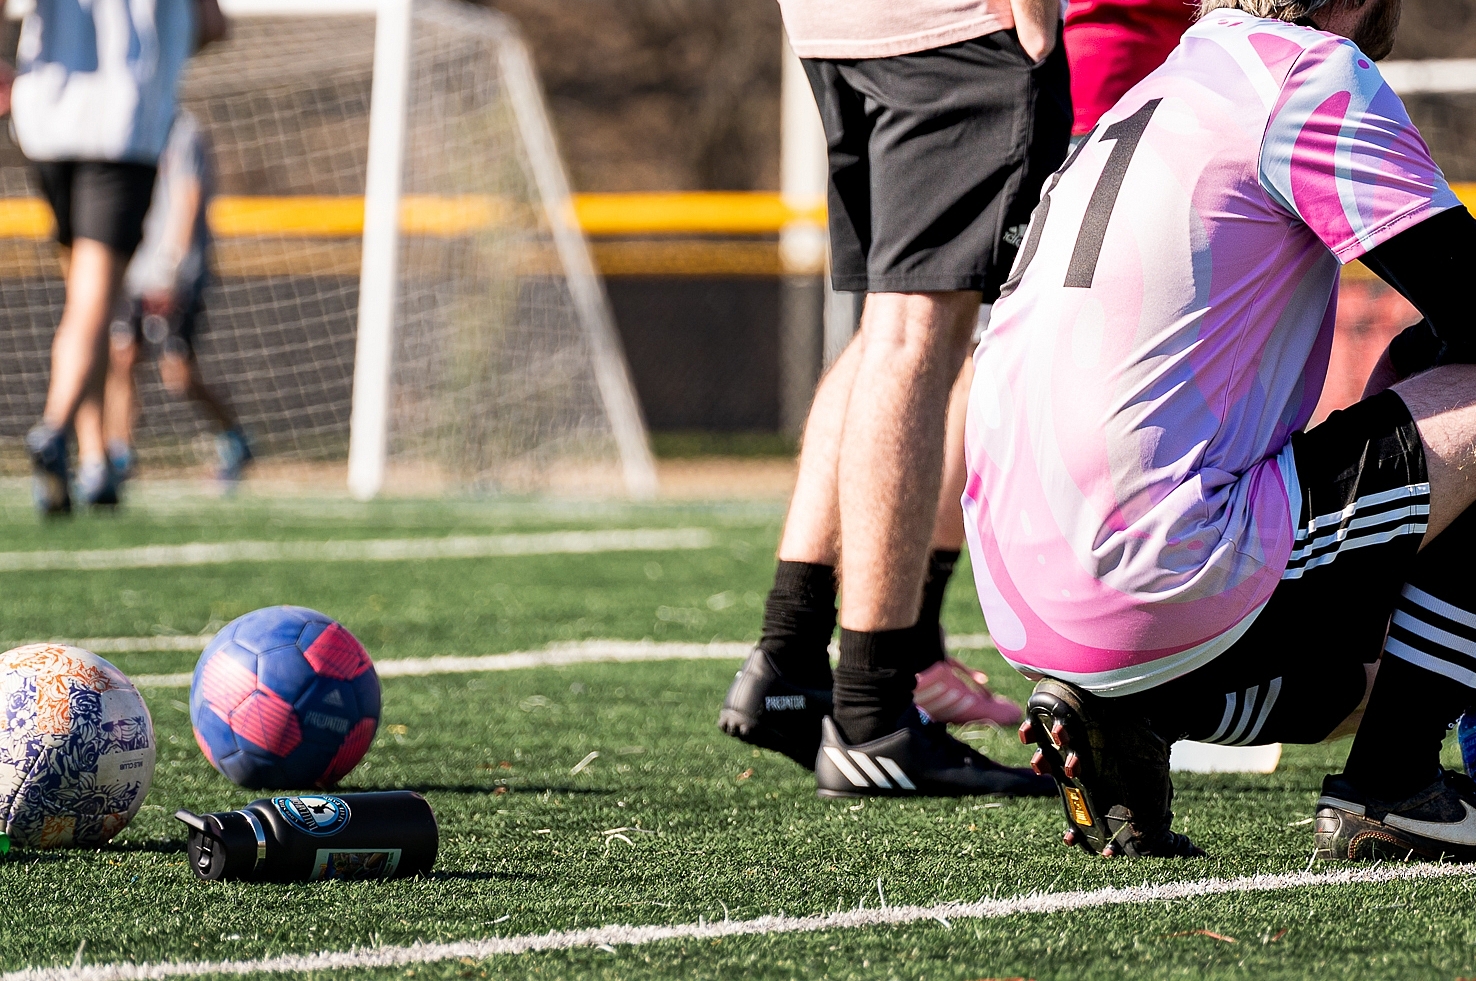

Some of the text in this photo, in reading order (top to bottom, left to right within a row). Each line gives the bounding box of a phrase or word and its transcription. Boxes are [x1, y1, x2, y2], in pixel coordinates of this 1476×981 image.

[764, 694, 807, 712] PREDATOR
[304, 710, 350, 734] PREDATOR
[119, 761, 134, 771] CLUB
